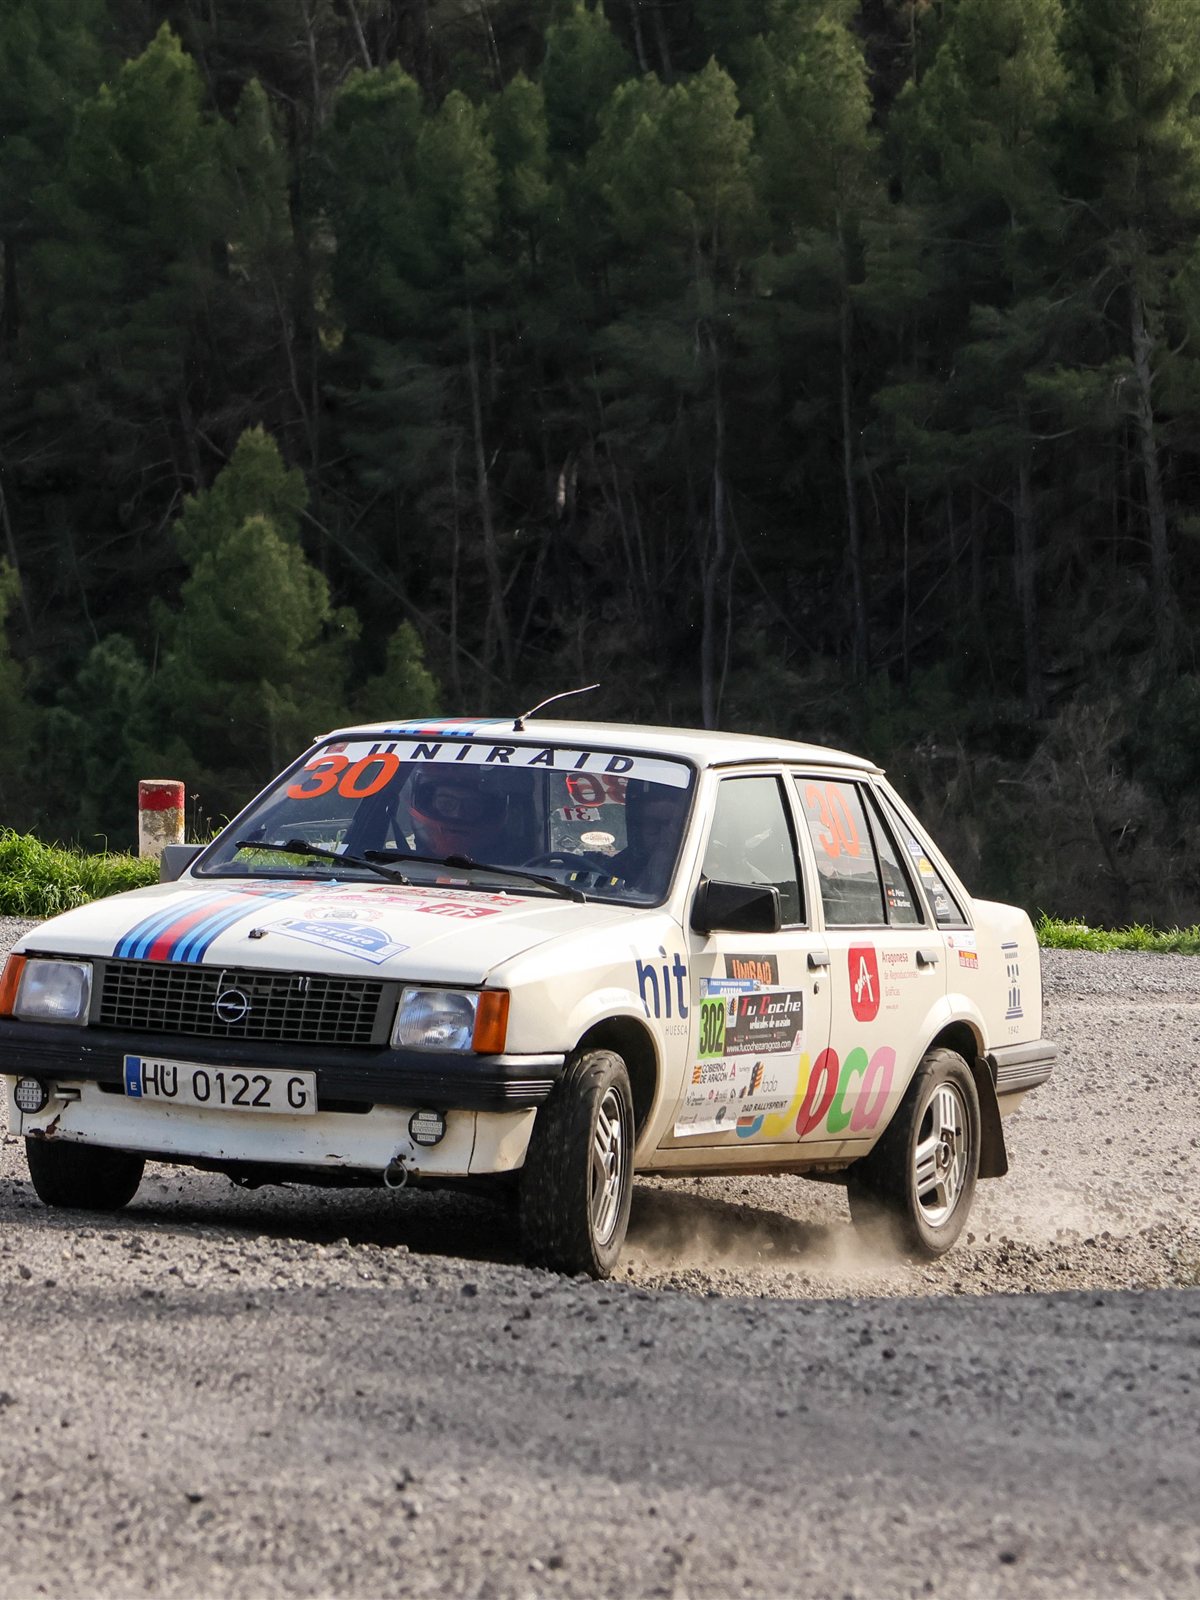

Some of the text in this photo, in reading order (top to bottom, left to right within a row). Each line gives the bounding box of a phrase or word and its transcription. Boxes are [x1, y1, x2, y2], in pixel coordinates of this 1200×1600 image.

[287, 752, 400, 800] 30
[368, 743, 634, 774] UNIRAID
[805, 783, 861, 858] 30
[629, 944, 688, 1019] hit
[741, 994, 801, 1017] Tu Coche
[665, 1024, 688, 1036] HUESCA
[699, 1002, 725, 1054] 302
[130, 1062, 307, 1109] E HU 0122 G
[699, 1074, 707, 1084] DE
[702, 1062, 727, 1073] GOBIERNO
